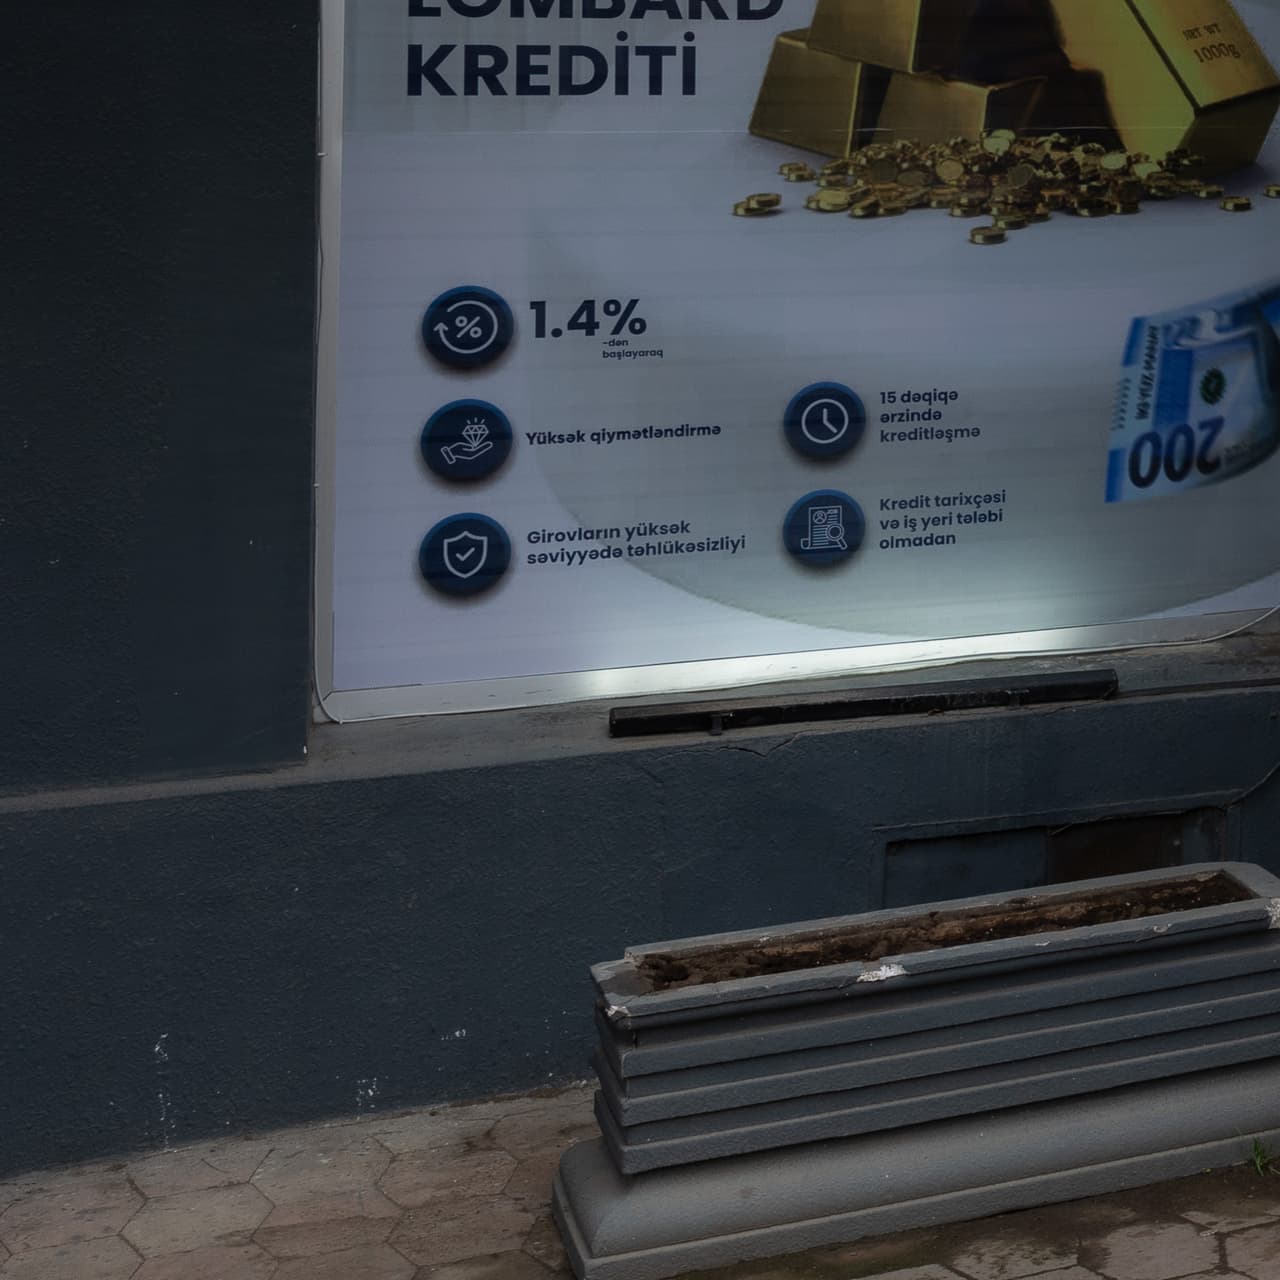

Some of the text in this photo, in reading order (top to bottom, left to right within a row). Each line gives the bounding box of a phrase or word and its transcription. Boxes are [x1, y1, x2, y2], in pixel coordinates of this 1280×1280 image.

[1194, 42, 1241, 62] 1000g
[407, 31, 696, 96] KREDİTİ
[530, 298, 647, 338] 1.4%
[602, 338, 629, 347] -dən
[602, 349, 664, 360] başlayaraq
[880, 388, 958, 405] 15 dəqiqə
[880, 408, 942, 423] ərzində
[526, 423, 722, 445] Yüksək qiymətləndirmə
[880, 426, 981, 443] kreditləşmə
[880, 489, 1006, 511] Kredit tarixçəsi
[880, 508, 1003, 532] və iş yeri tələbi
[527, 520, 691, 544] Girovların yüksək
[880, 533, 956, 549] olmadan
[527, 535, 746, 566] səviyyədə təhlükəsizliyi
